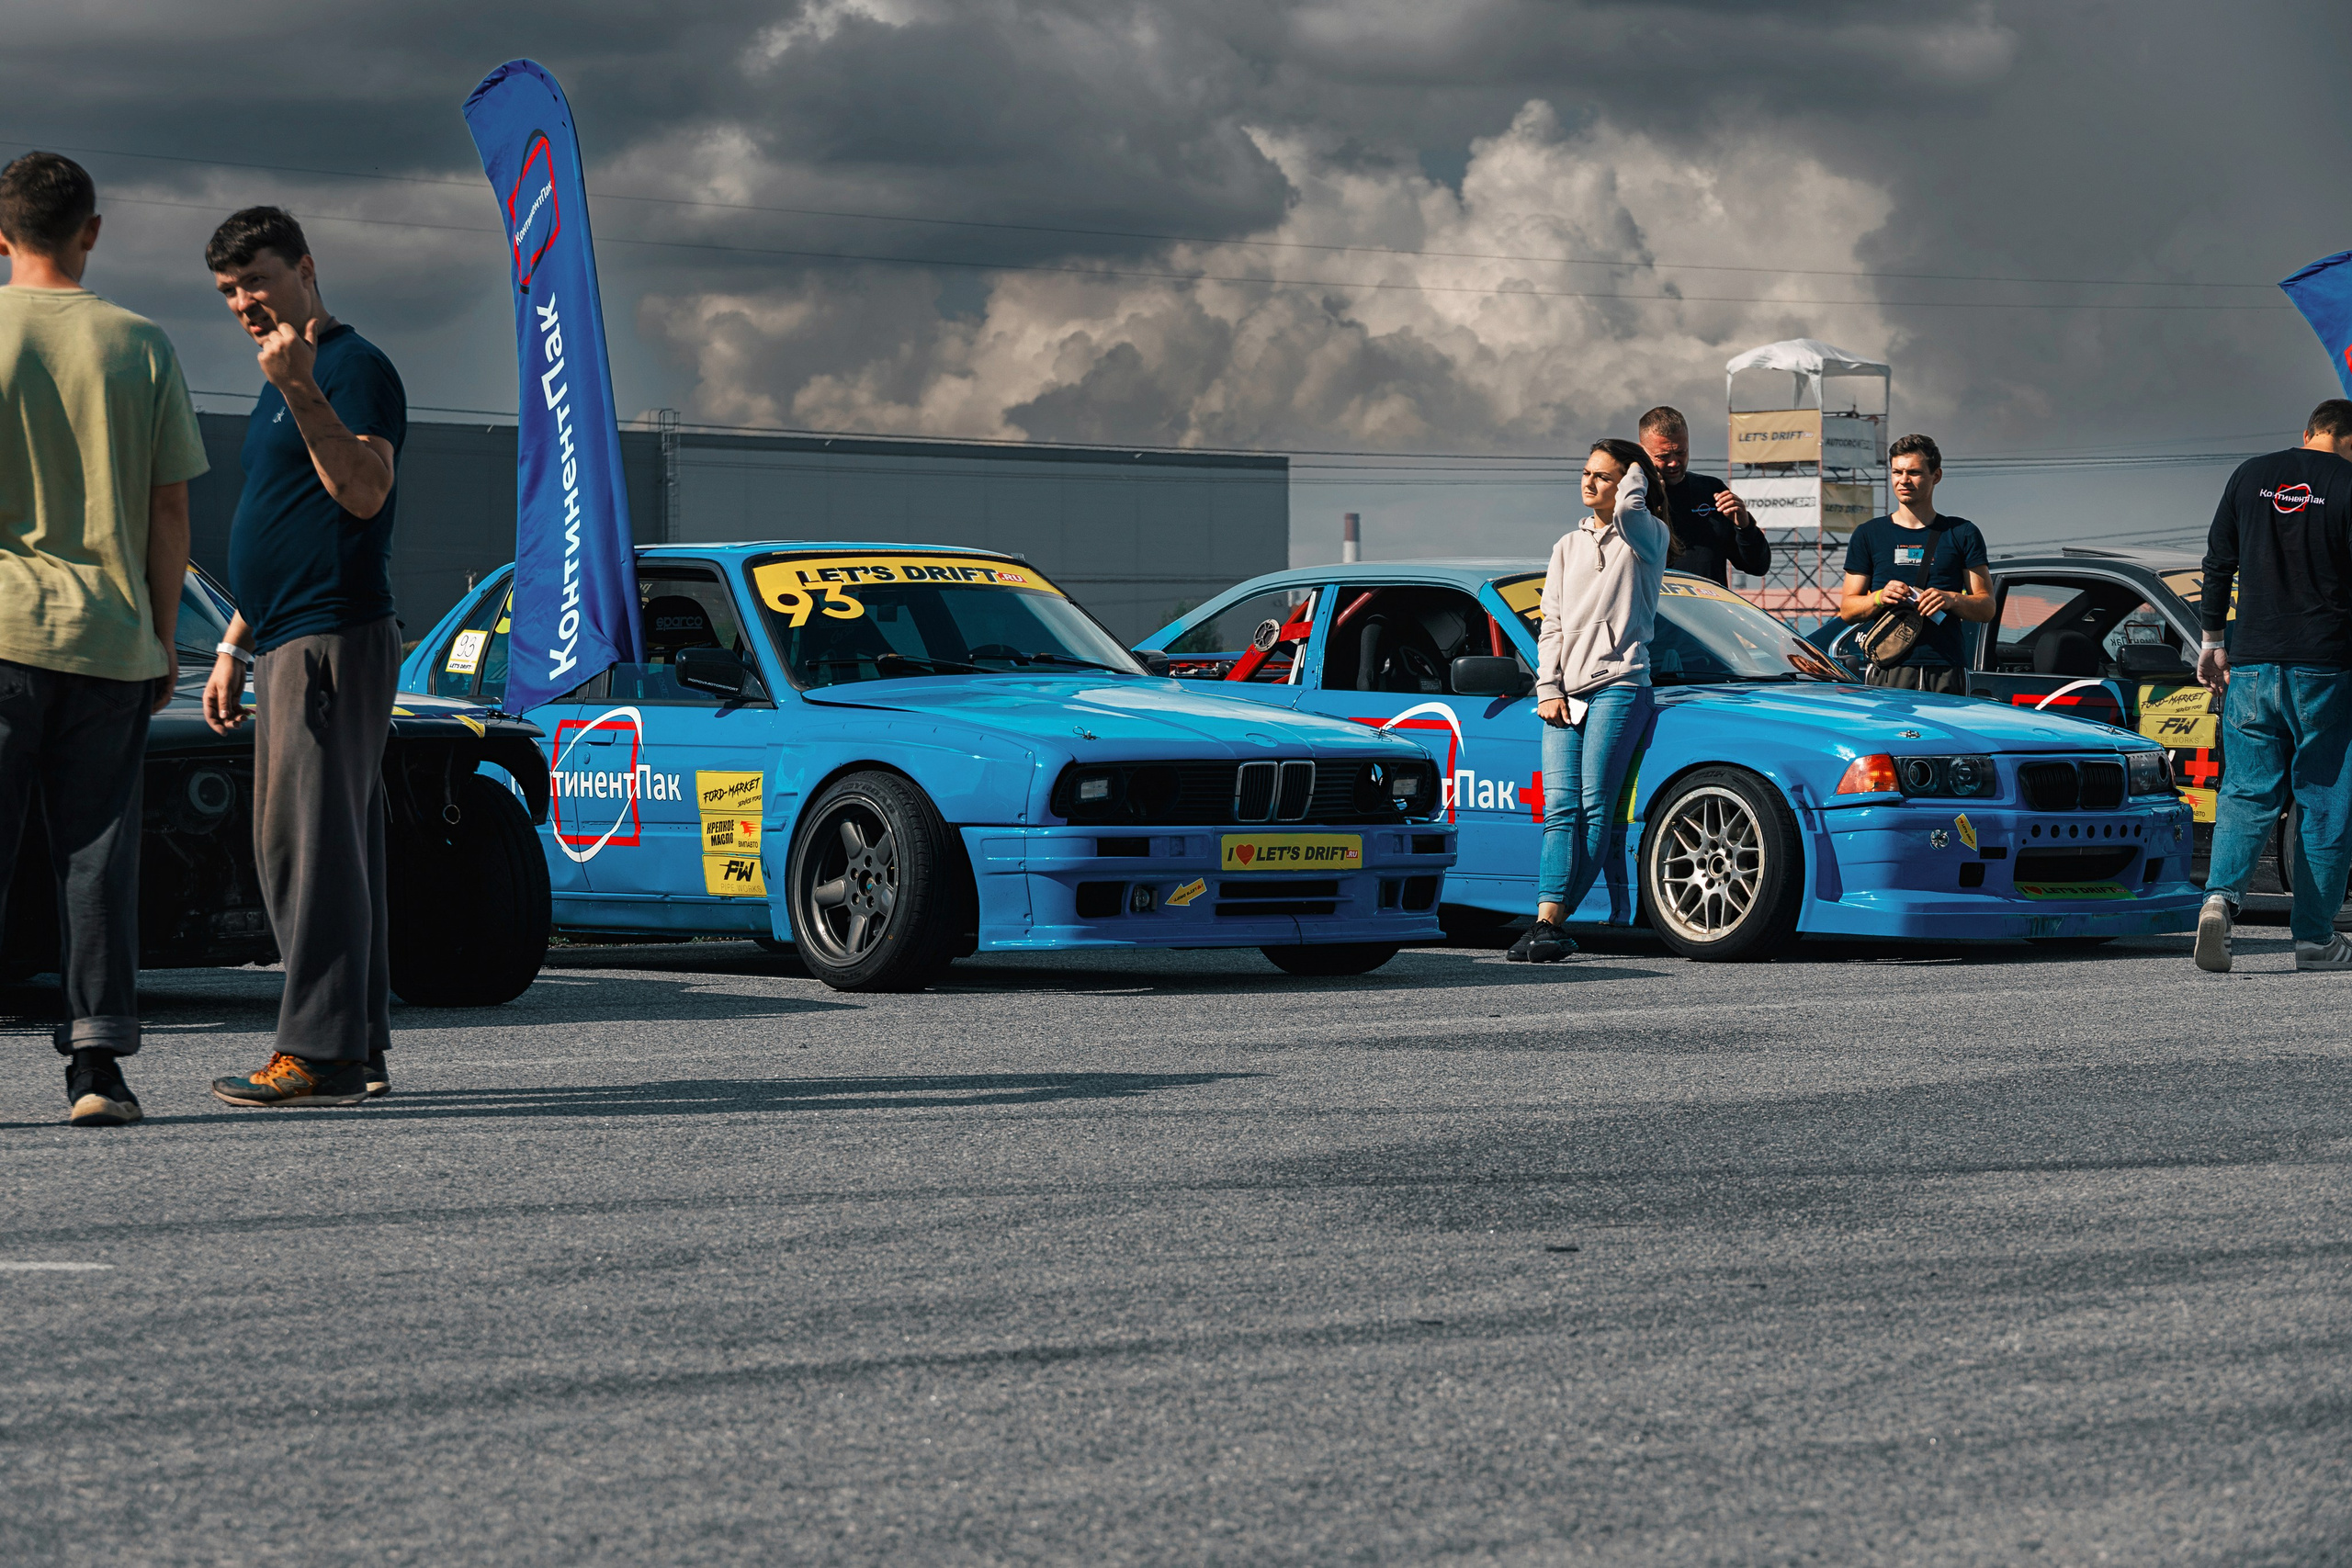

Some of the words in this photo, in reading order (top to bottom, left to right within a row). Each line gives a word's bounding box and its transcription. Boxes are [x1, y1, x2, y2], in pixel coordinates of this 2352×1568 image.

[515, 180, 552, 246] КонтинентПак
[1739, 432, 1769, 442] LET'S
[1771, 431, 1804, 441] DRIFT
[536, 291, 581, 681] КонтинентПак
[1745, 499, 1795, 507] UTODROM
[796, 566, 897, 586] LET'S
[901, 566, 999, 583] DRIFT
[763, 581, 865, 628] 93
[457, 635, 477, 658] 93
[2141, 692, 2207, 709] FORD-MARKET
[511, 764, 682, 801] тинентПак
[703, 777, 761, 805] FORD-MARKET
[707, 819, 734, 835] КРЕПКОЕ
[710, 832, 734, 847] МАСЛО
[738, 840, 758, 849] ВМПАВТО
[1227, 847, 1234, 862] I
[1256, 846, 1300, 862] LET'S
[1305, 846, 1348, 861] DRIFT
[720, 883, 735, 893] PIPE
[737, 884, 763, 894] WORKS
